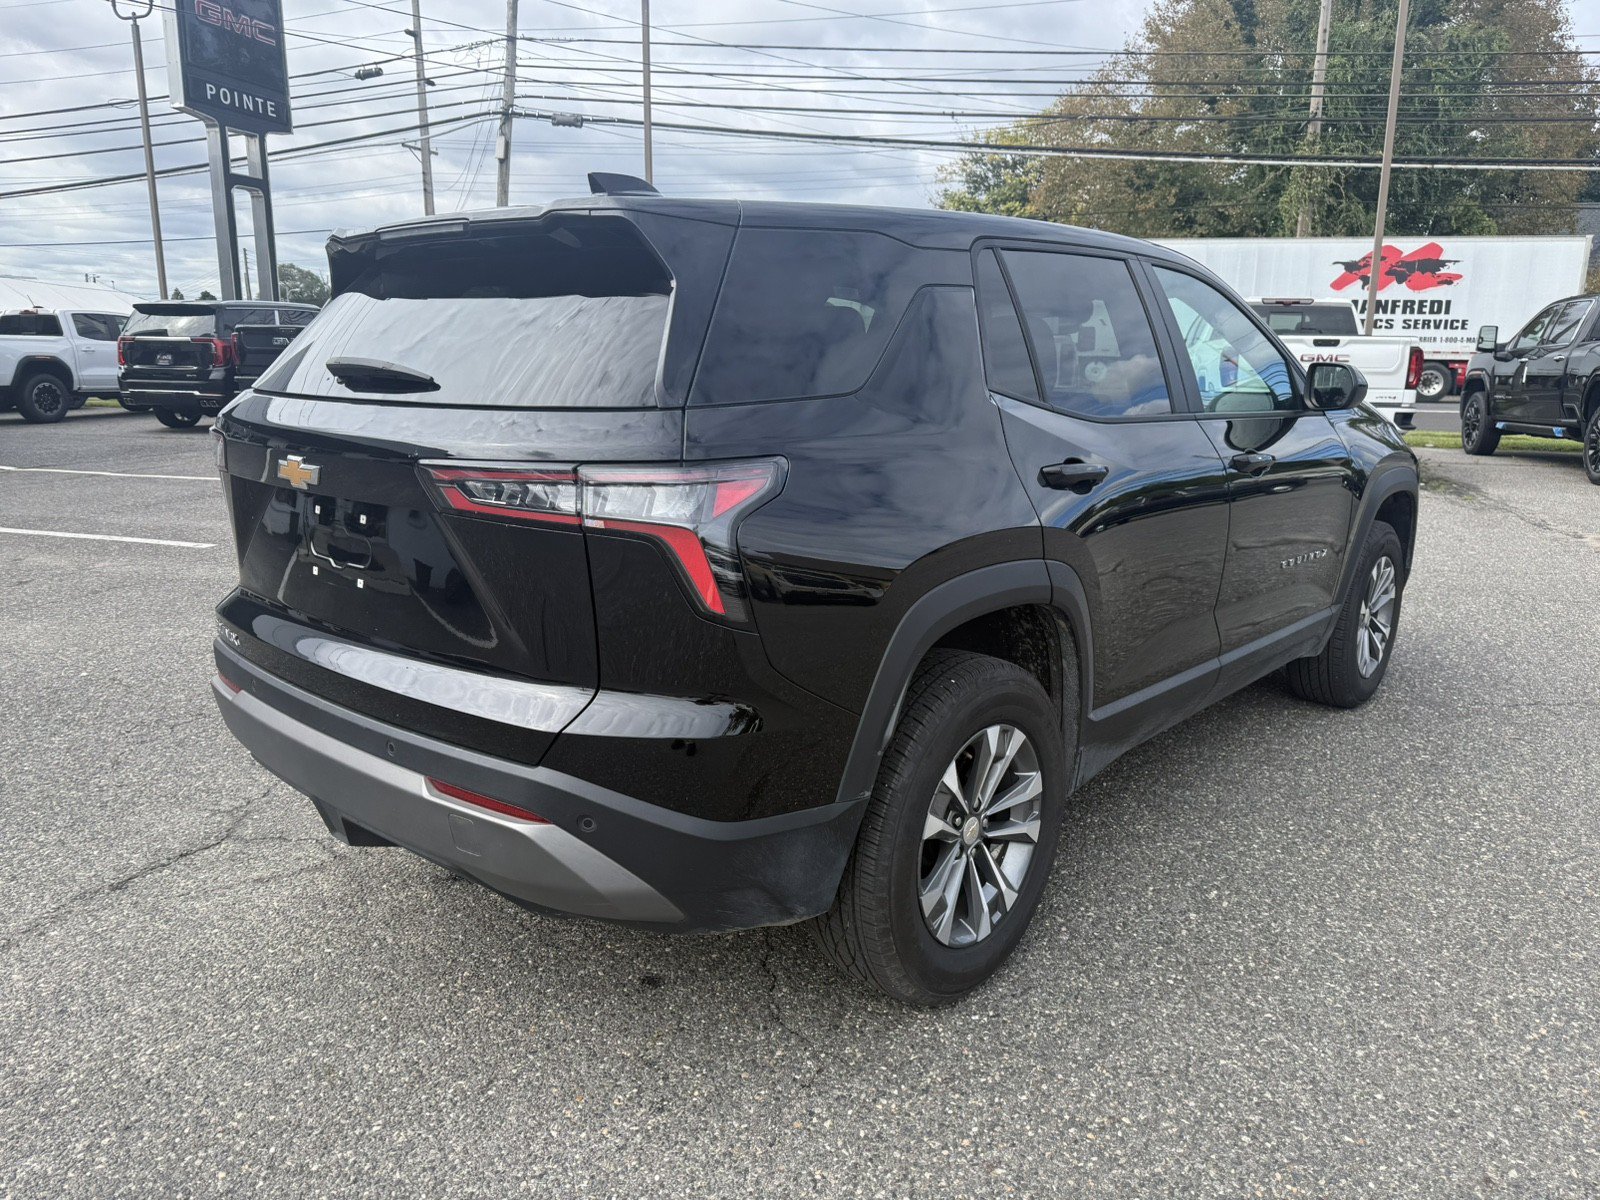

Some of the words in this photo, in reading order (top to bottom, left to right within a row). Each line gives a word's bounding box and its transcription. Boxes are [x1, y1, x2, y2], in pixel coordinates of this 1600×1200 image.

[195, 0, 276, 46] GMC
[205, 83, 277, 117] POINTE
[1402, 319, 1469, 330] SERVICE
[1300, 354, 1350, 363] GMC
